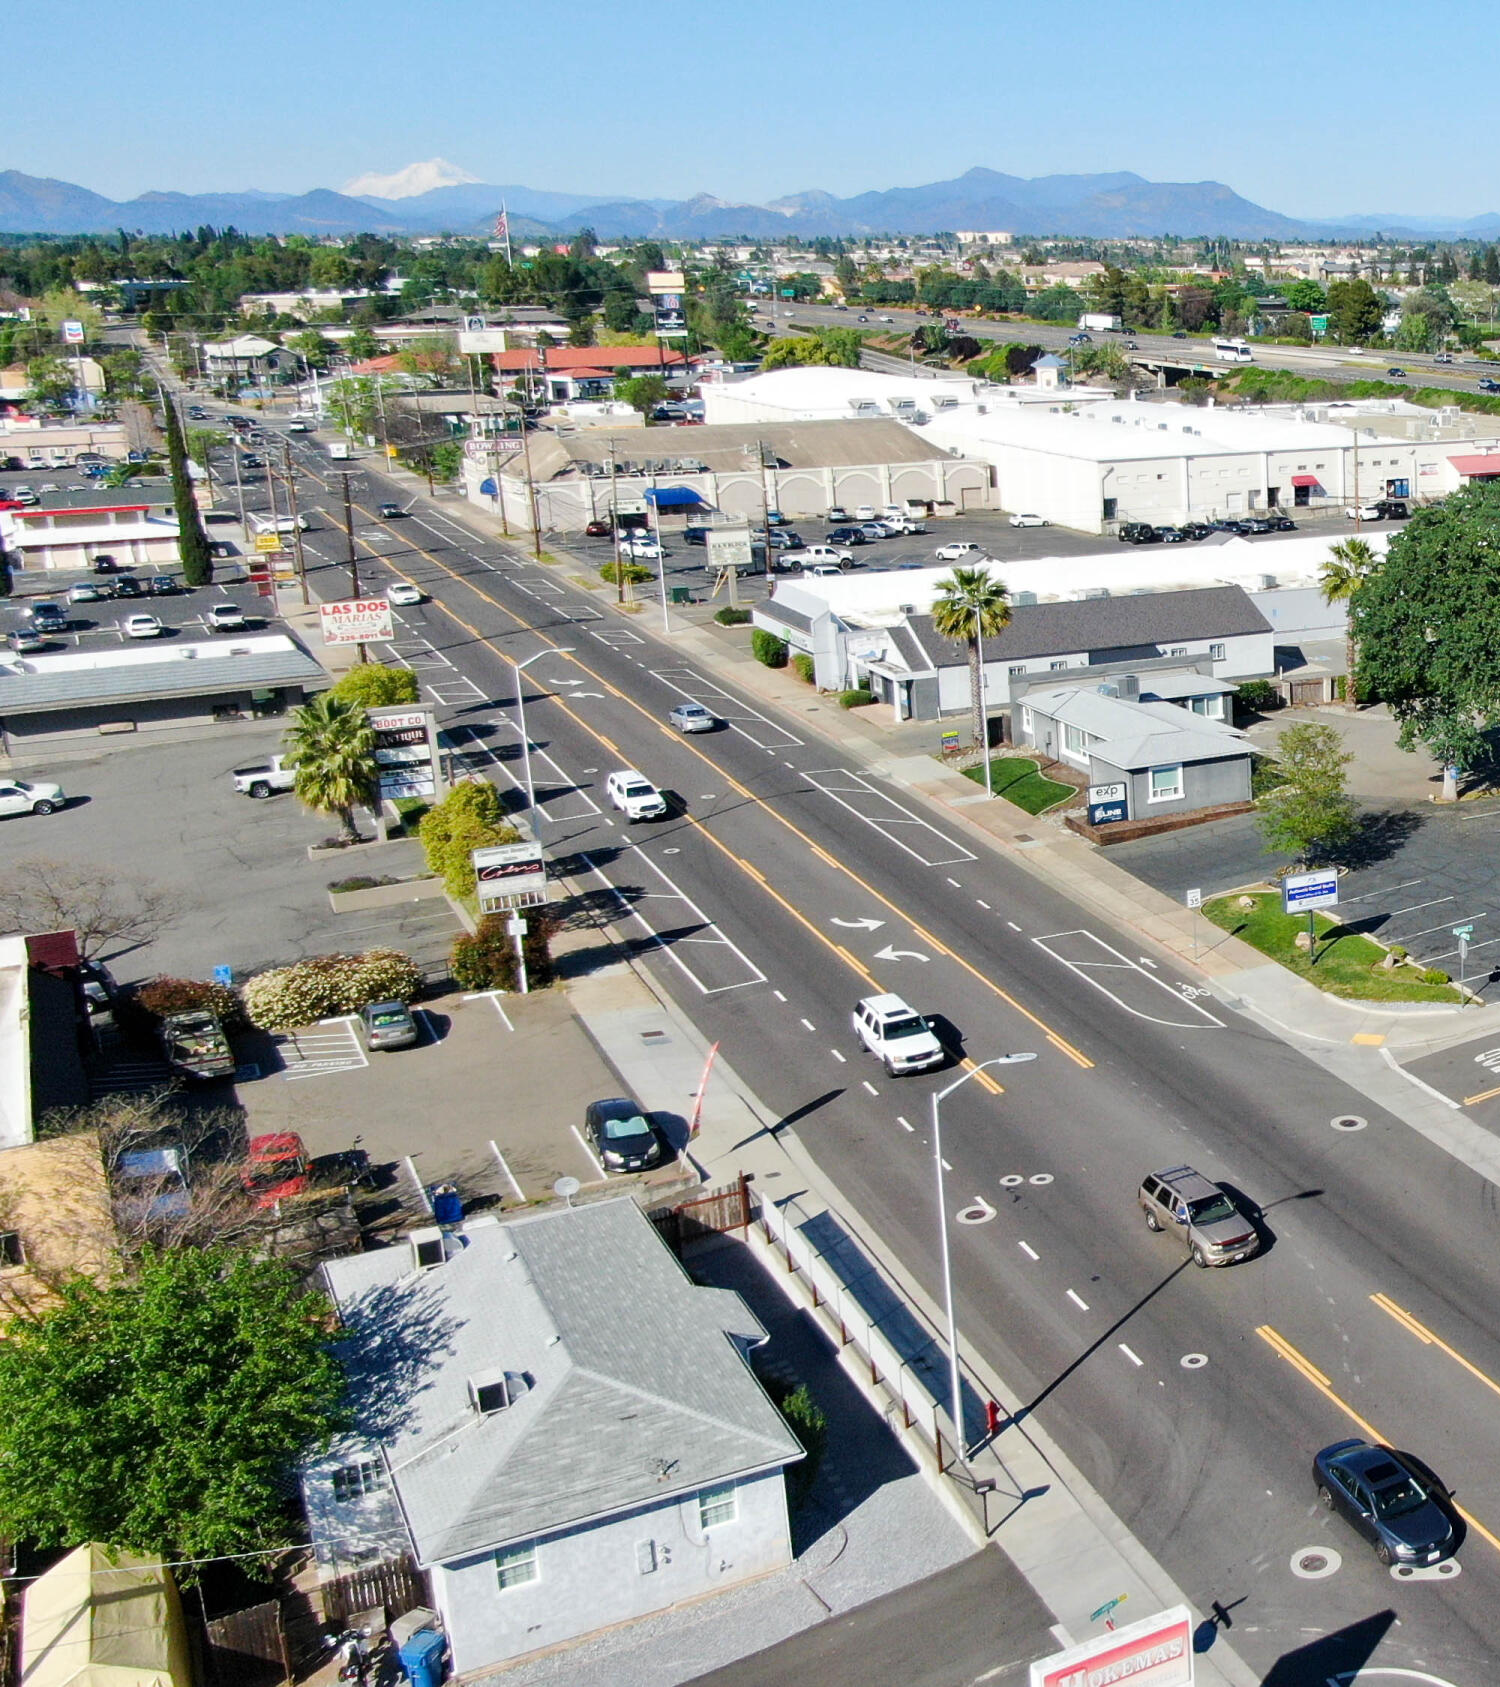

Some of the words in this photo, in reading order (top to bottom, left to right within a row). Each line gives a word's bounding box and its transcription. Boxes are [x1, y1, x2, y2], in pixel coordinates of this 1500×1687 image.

[469, 441, 520, 450] BOWING
[321, 604, 352, 616] LAS
[355, 601, 388, 613] DOS
[332, 612, 382, 624] MARIAS
[376, 718, 404, 729] BOOT
[407, 716, 422, 725] CO
[379, 730, 424, 746] ANTIQUE
[1096, 785, 1118, 797] exp
[1190, 896, 1199, 905] 35
